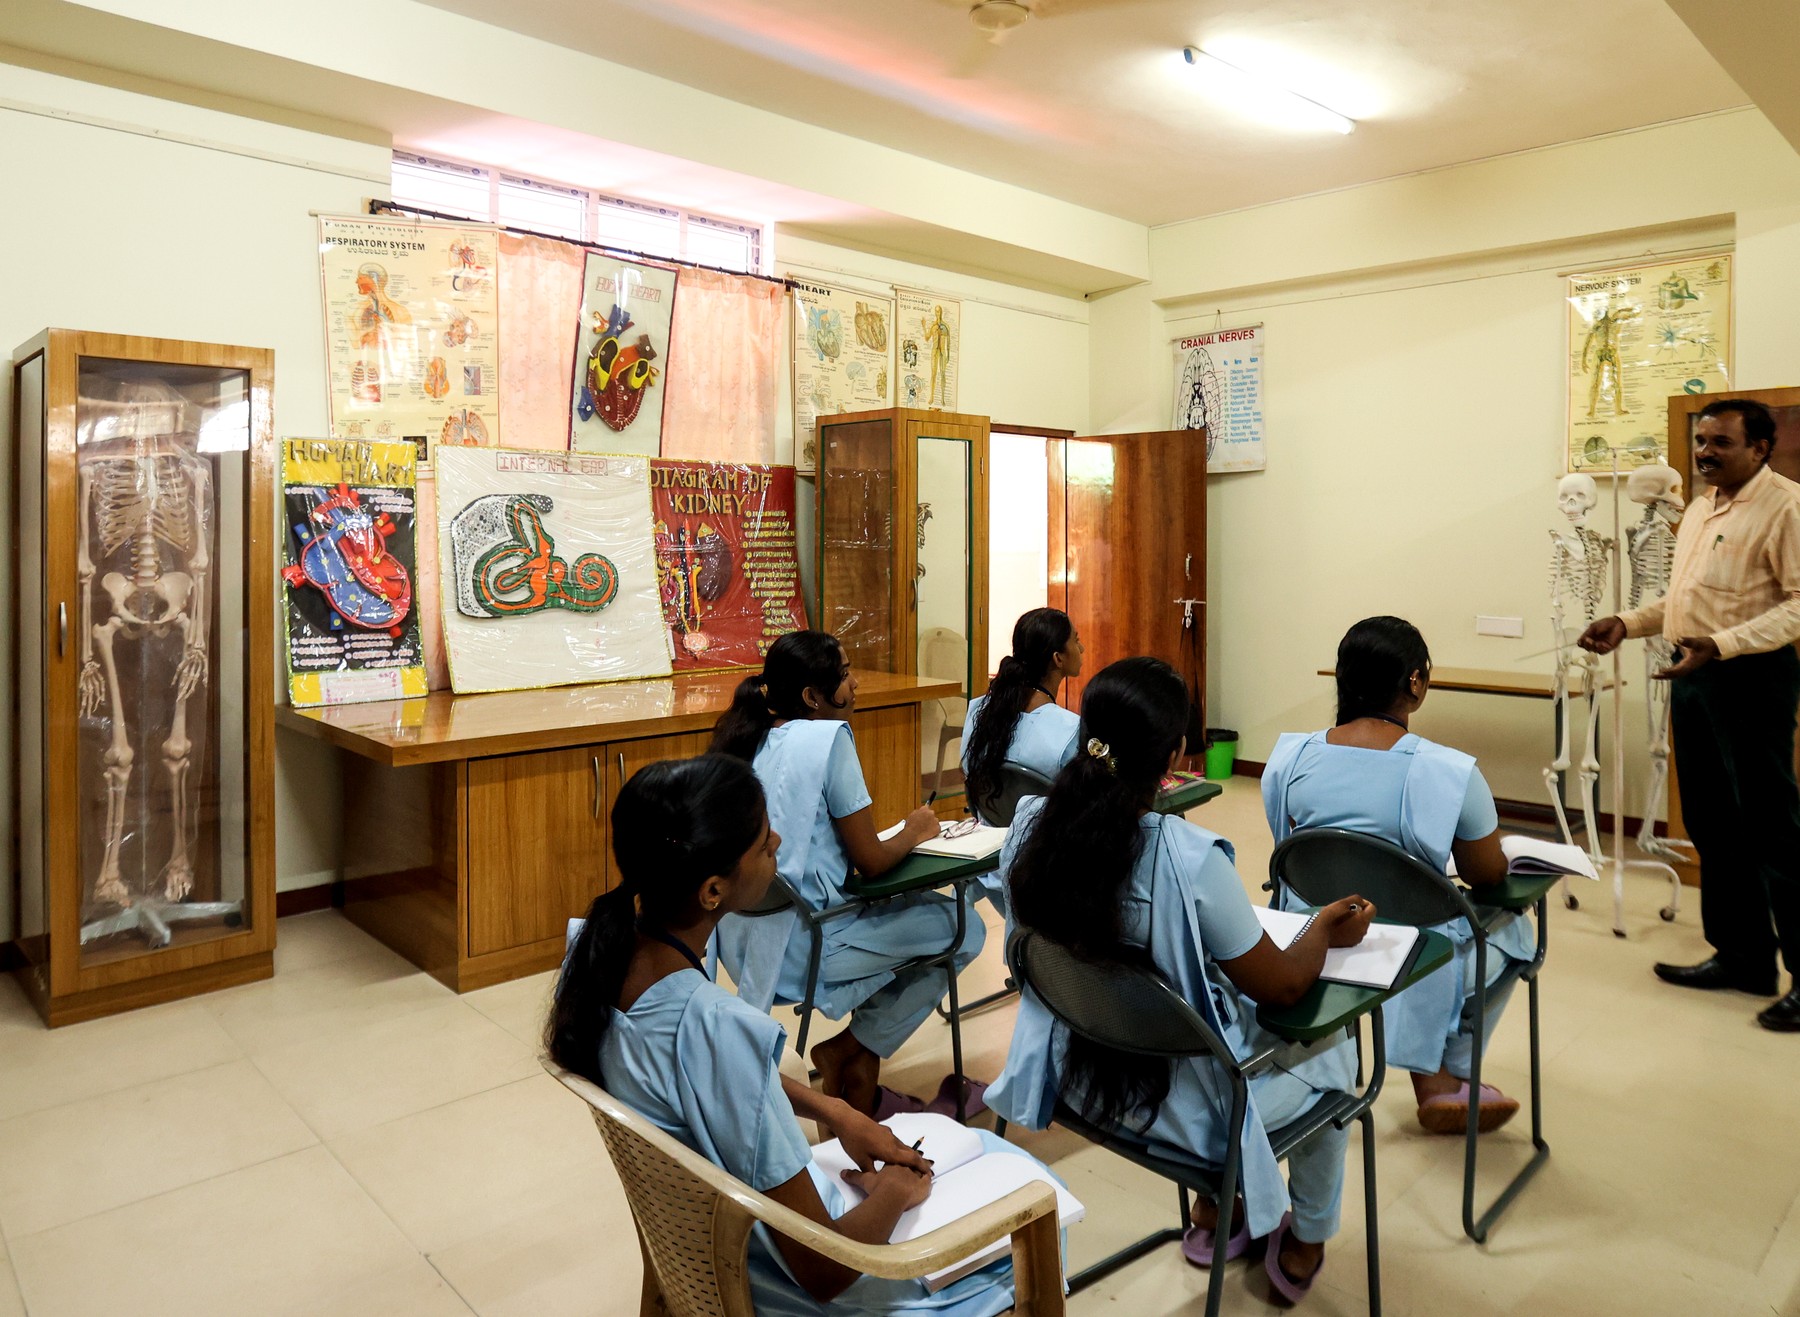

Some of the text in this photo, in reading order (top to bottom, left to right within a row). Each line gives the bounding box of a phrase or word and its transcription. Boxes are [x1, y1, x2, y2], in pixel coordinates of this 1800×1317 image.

[325, 236, 426, 251] RESPIRATORY SYSTEM
[798, 283, 831, 297] HEART
[1575, 277, 1642, 292] NERVOUS SYTEM
[1180, 329, 1255, 350] CRANIAL NERVES
[290, 440, 373, 463] HUMAN
[650, 467, 773, 492] DIAGRAM OF
[674, 494, 748, 515] KIDNEY
